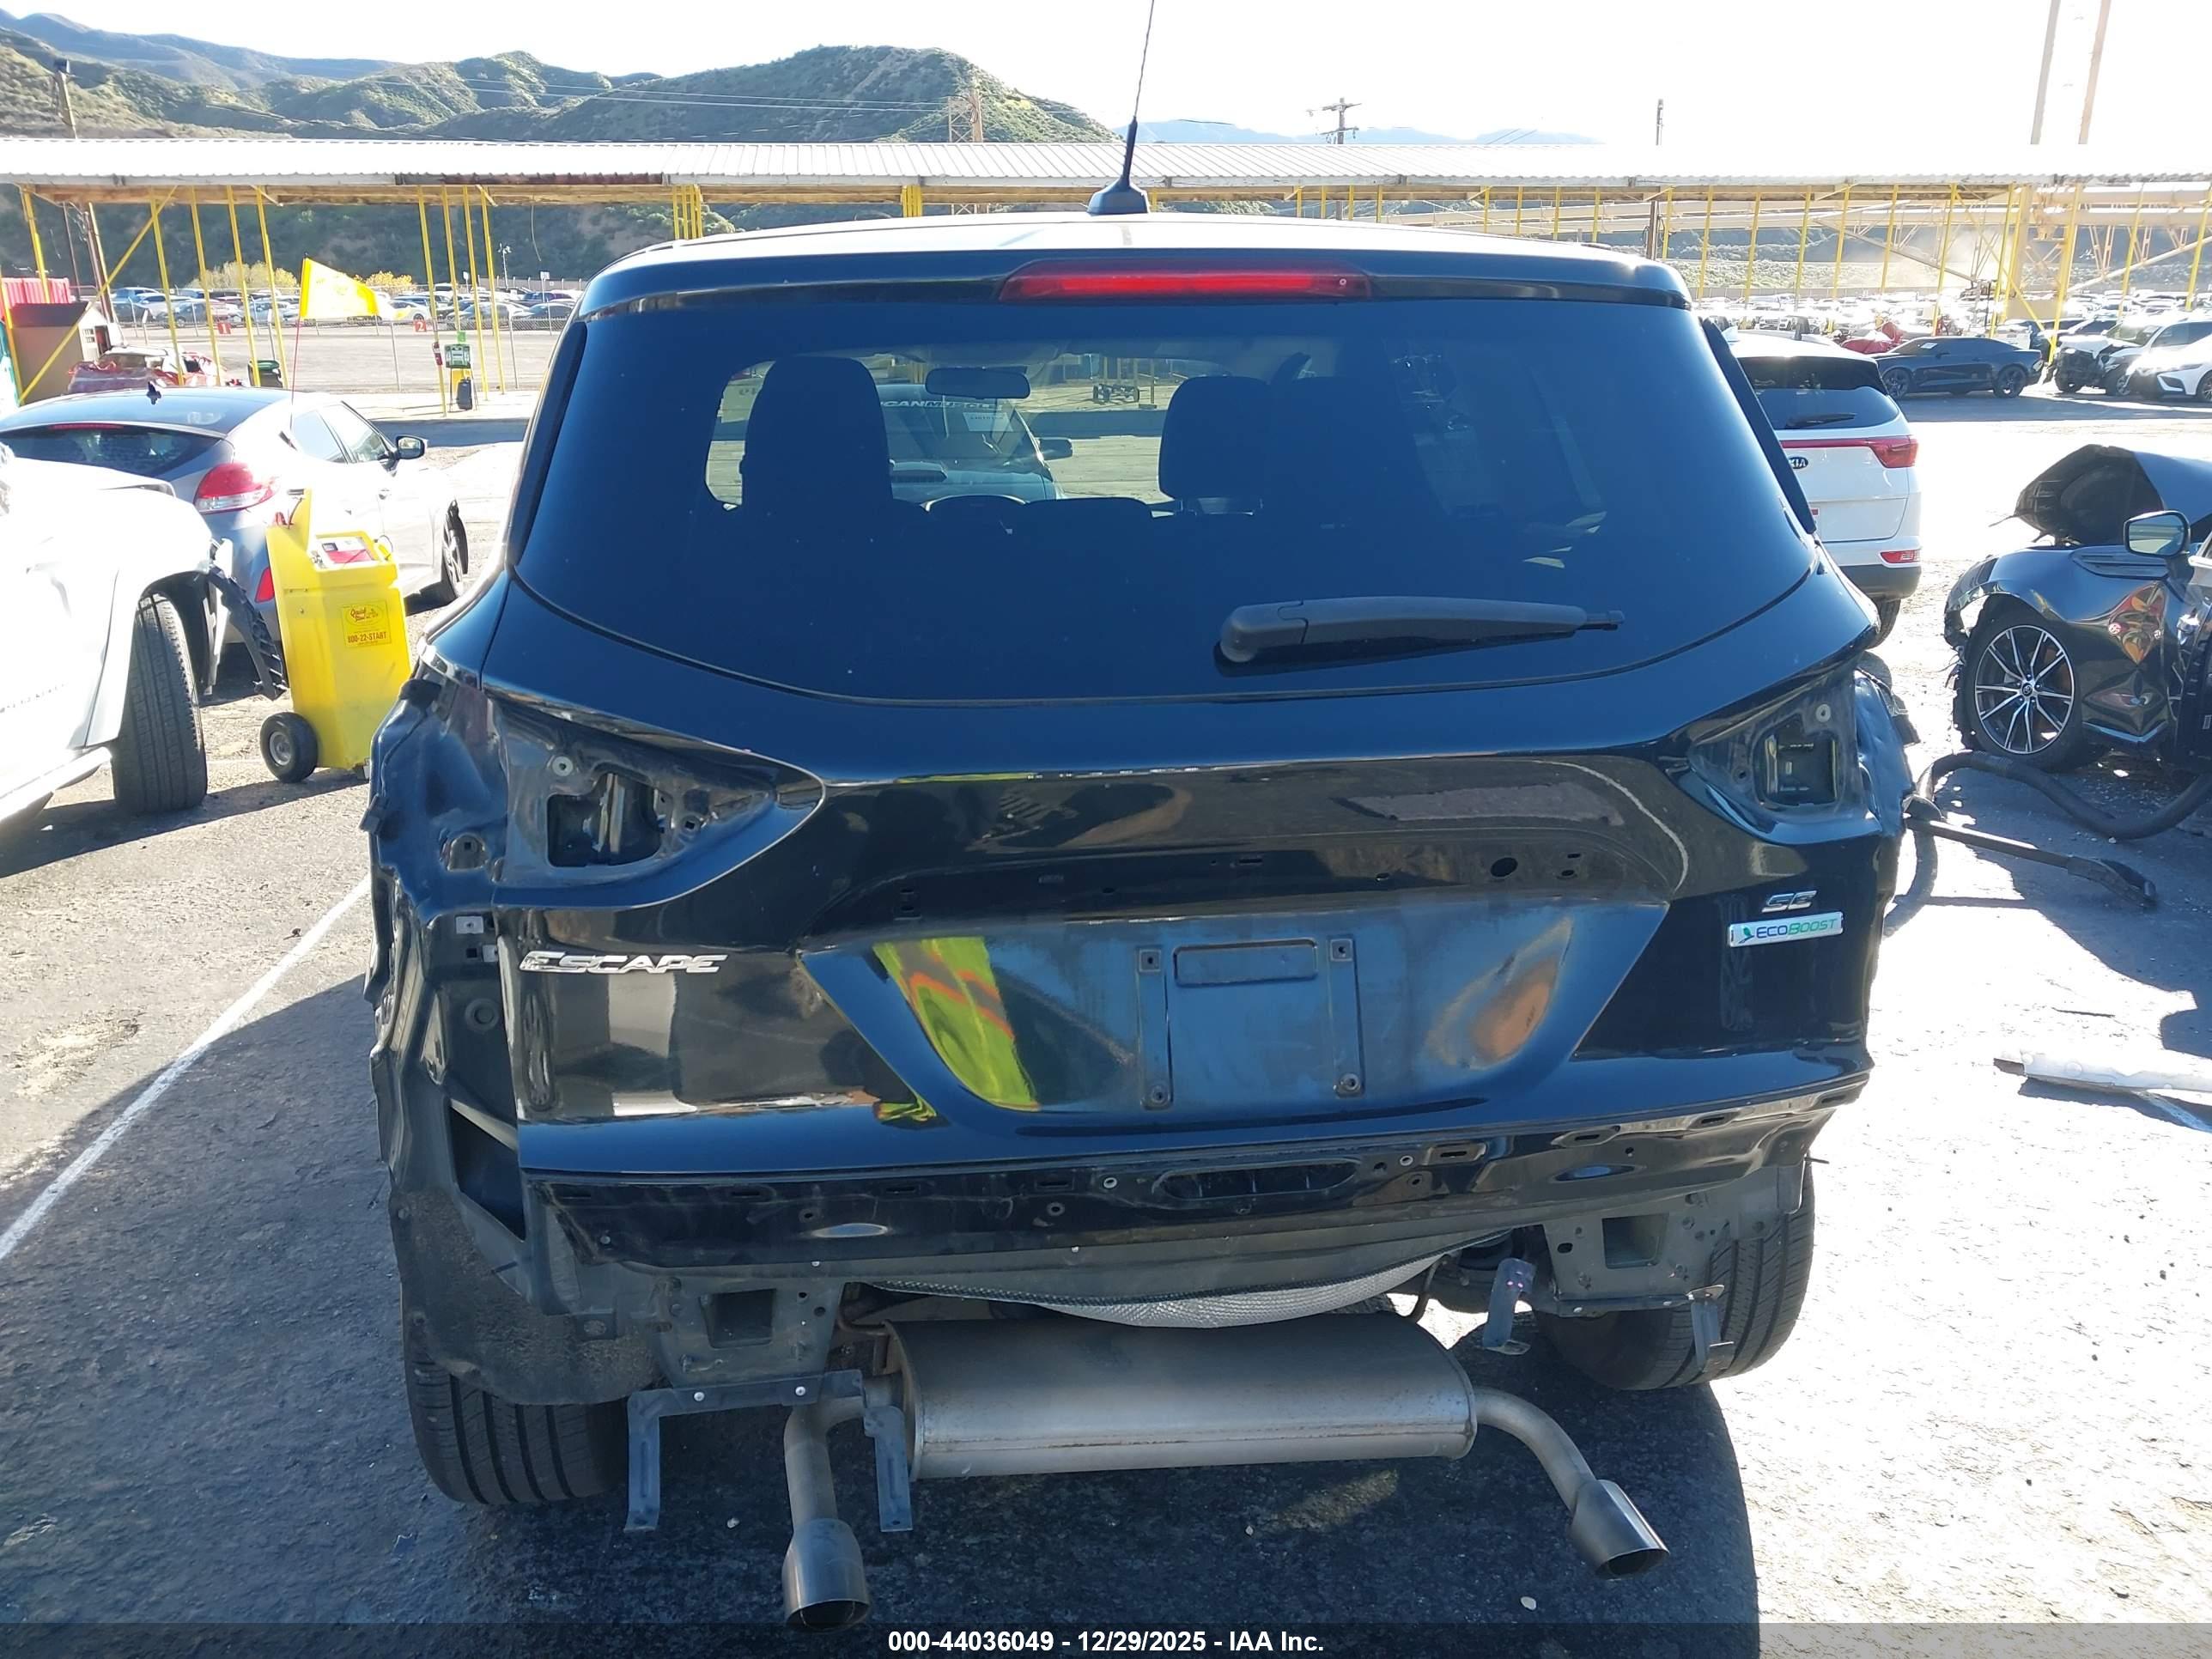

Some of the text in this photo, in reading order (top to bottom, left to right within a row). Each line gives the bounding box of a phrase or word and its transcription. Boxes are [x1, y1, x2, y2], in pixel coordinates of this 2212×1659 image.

[416, 321, 425, 331] 2
[1789, 458, 1807, 468] KIA
[1761, 890, 1817, 912] SE
[519, 951, 728, 974] ESCAPE
